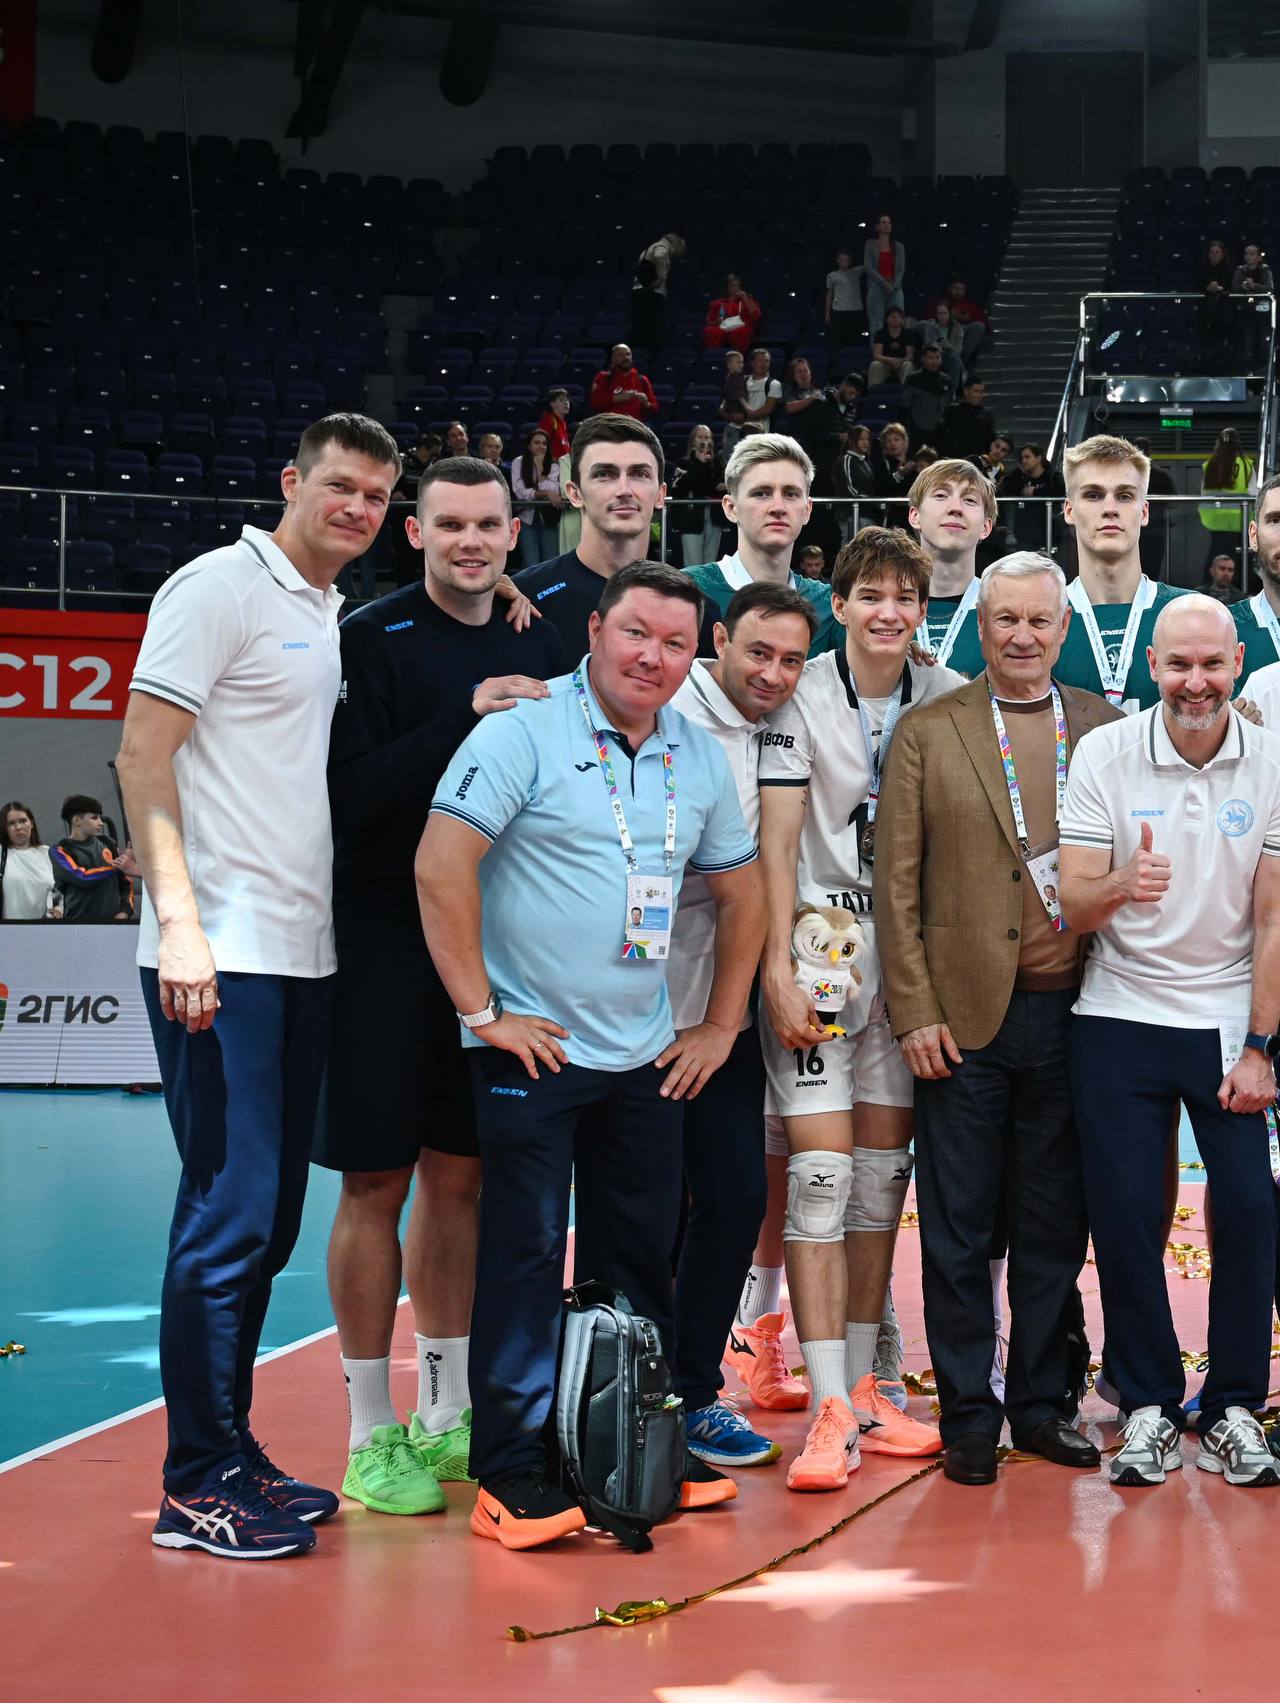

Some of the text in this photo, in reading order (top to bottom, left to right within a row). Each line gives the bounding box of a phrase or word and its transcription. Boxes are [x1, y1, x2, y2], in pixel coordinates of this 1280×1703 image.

[1162, 419, 1191, 428] ВЫХОД
[536, 581, 567, 601] ENSEN
[384, 619, 415, 633] ENSEN
[763, 732, 796, 750] ВФВ
[1130, 809, 1165, 817] ENSEN
[17, 995, 120, 1025] 2ГИС
[793, 1045, 825, 1077] 16
[795, 1080, 828, 1088] ENSEN
[491, 1086, 528, 1098] ENSEN
